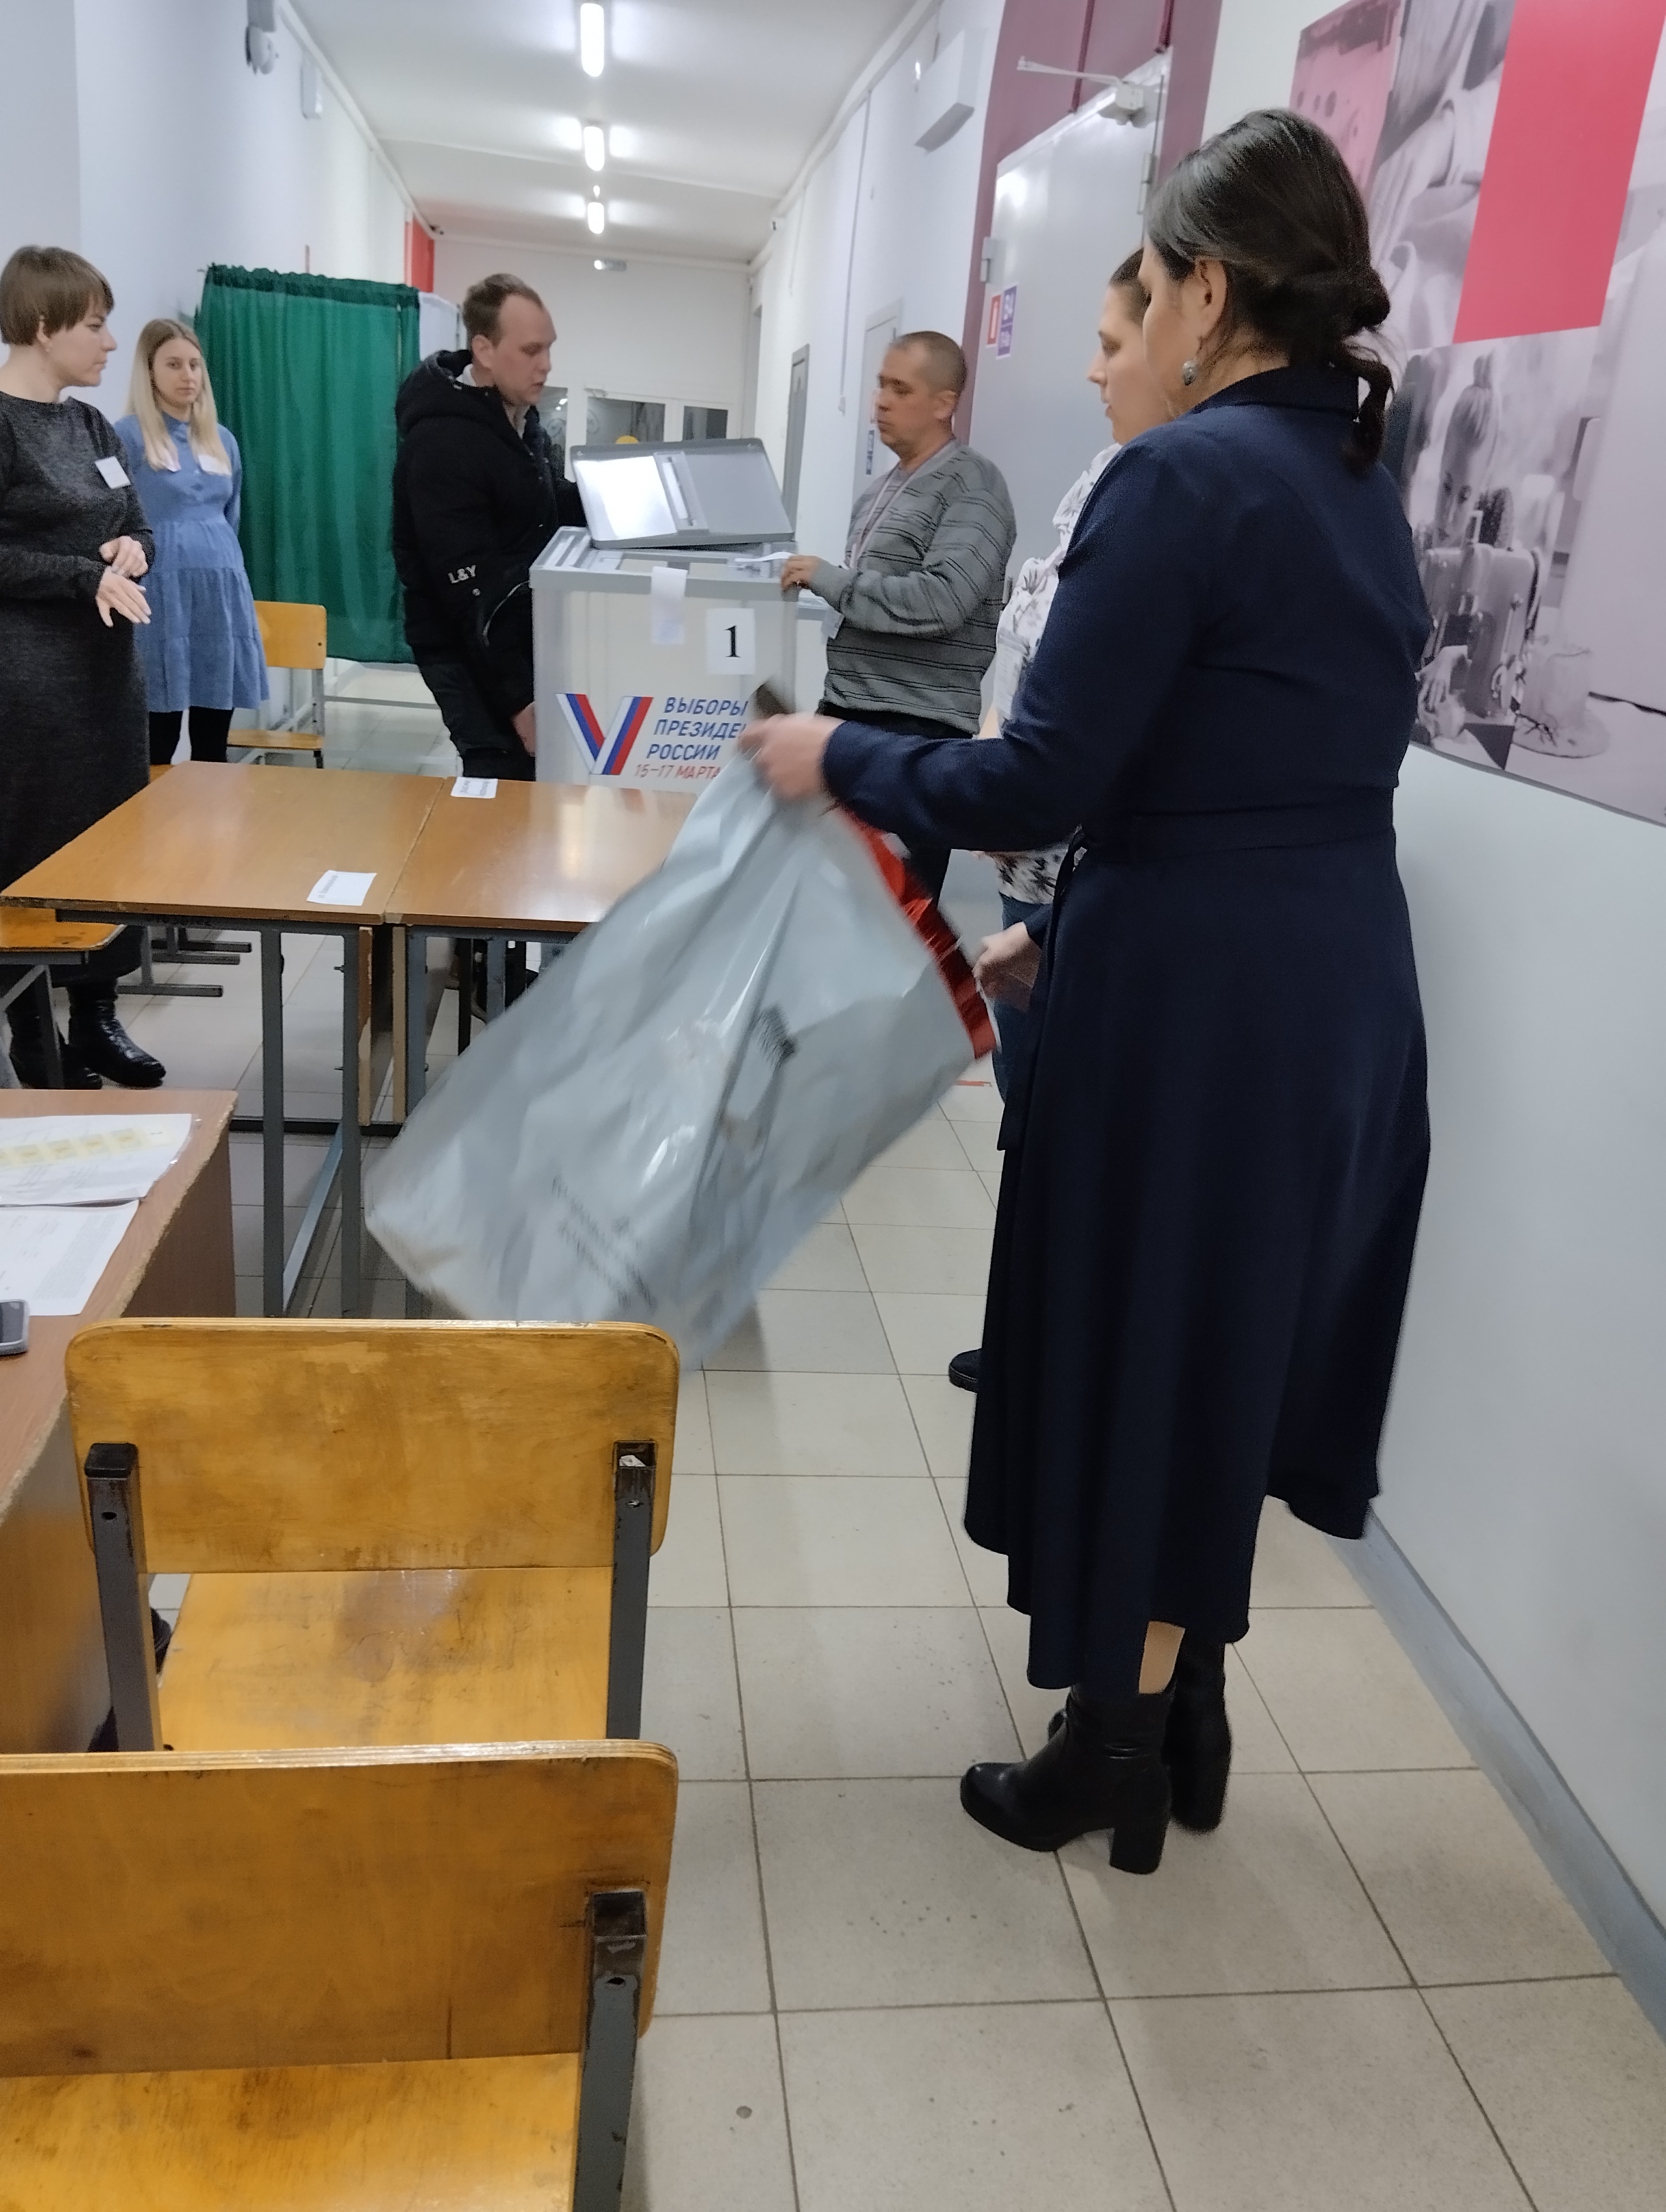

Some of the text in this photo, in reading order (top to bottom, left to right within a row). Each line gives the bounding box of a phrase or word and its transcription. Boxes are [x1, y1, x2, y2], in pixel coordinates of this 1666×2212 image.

[723, 625, 741, 658] 1
[663, 697, 749, 716] ВЫБОРЫ
[646, 743, 721, 761] РОССИИ
